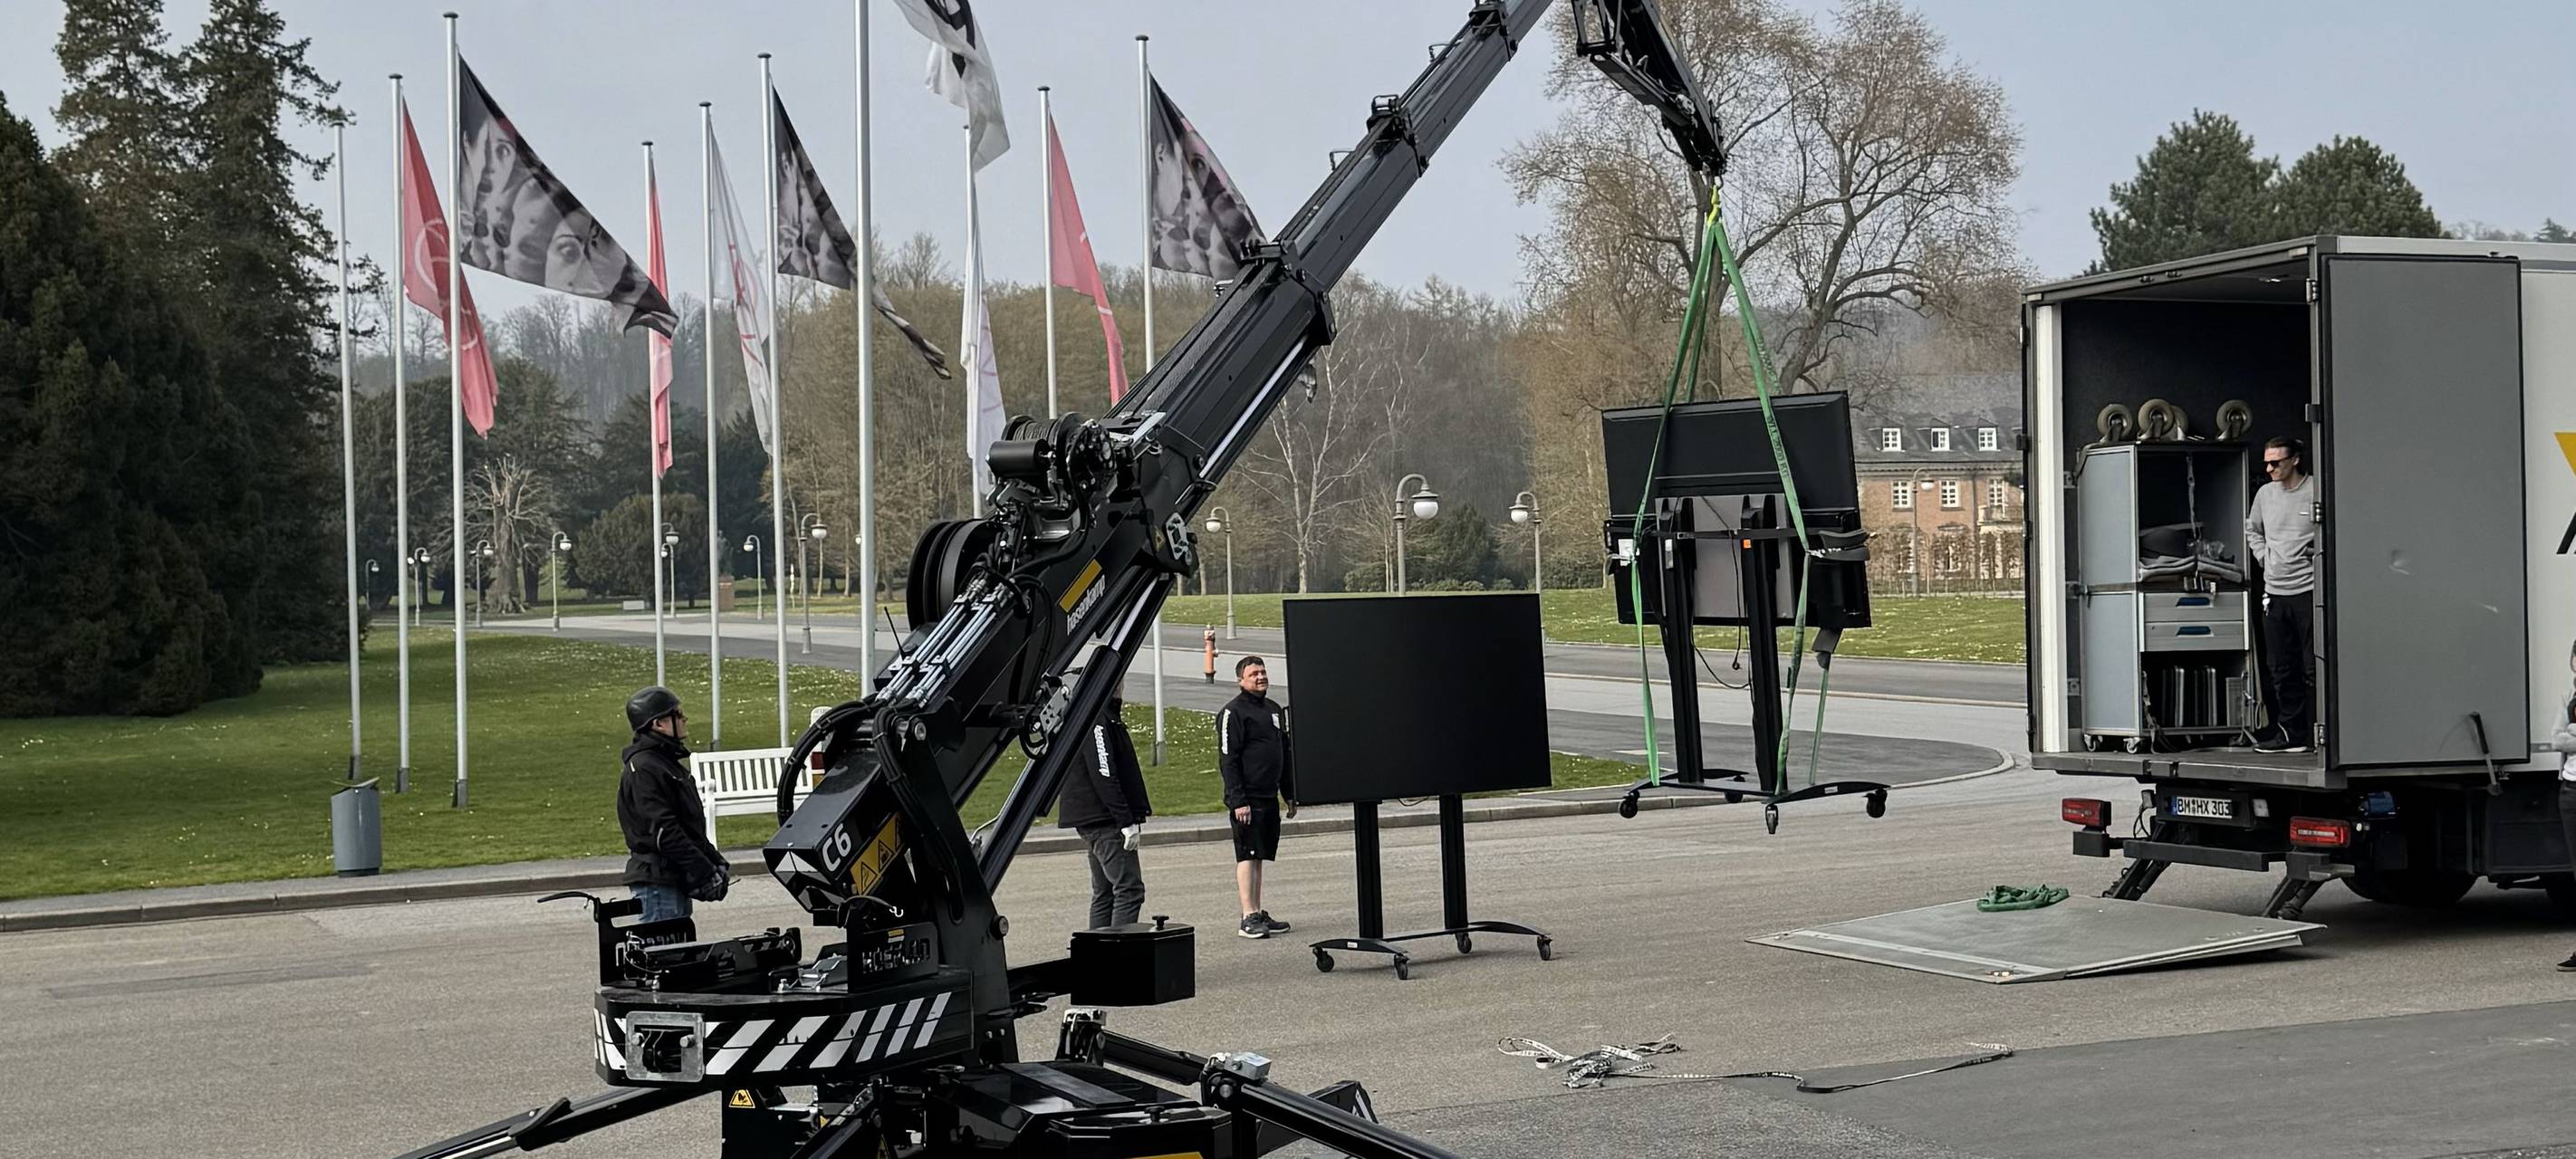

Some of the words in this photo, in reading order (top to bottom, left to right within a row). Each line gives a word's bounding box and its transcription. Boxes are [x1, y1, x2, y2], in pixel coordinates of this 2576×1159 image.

[1067, 573, 1105, 636] hasenkamp
[2196, 799, 2210, 815] HX
[822, 822, 851, 872] C6
